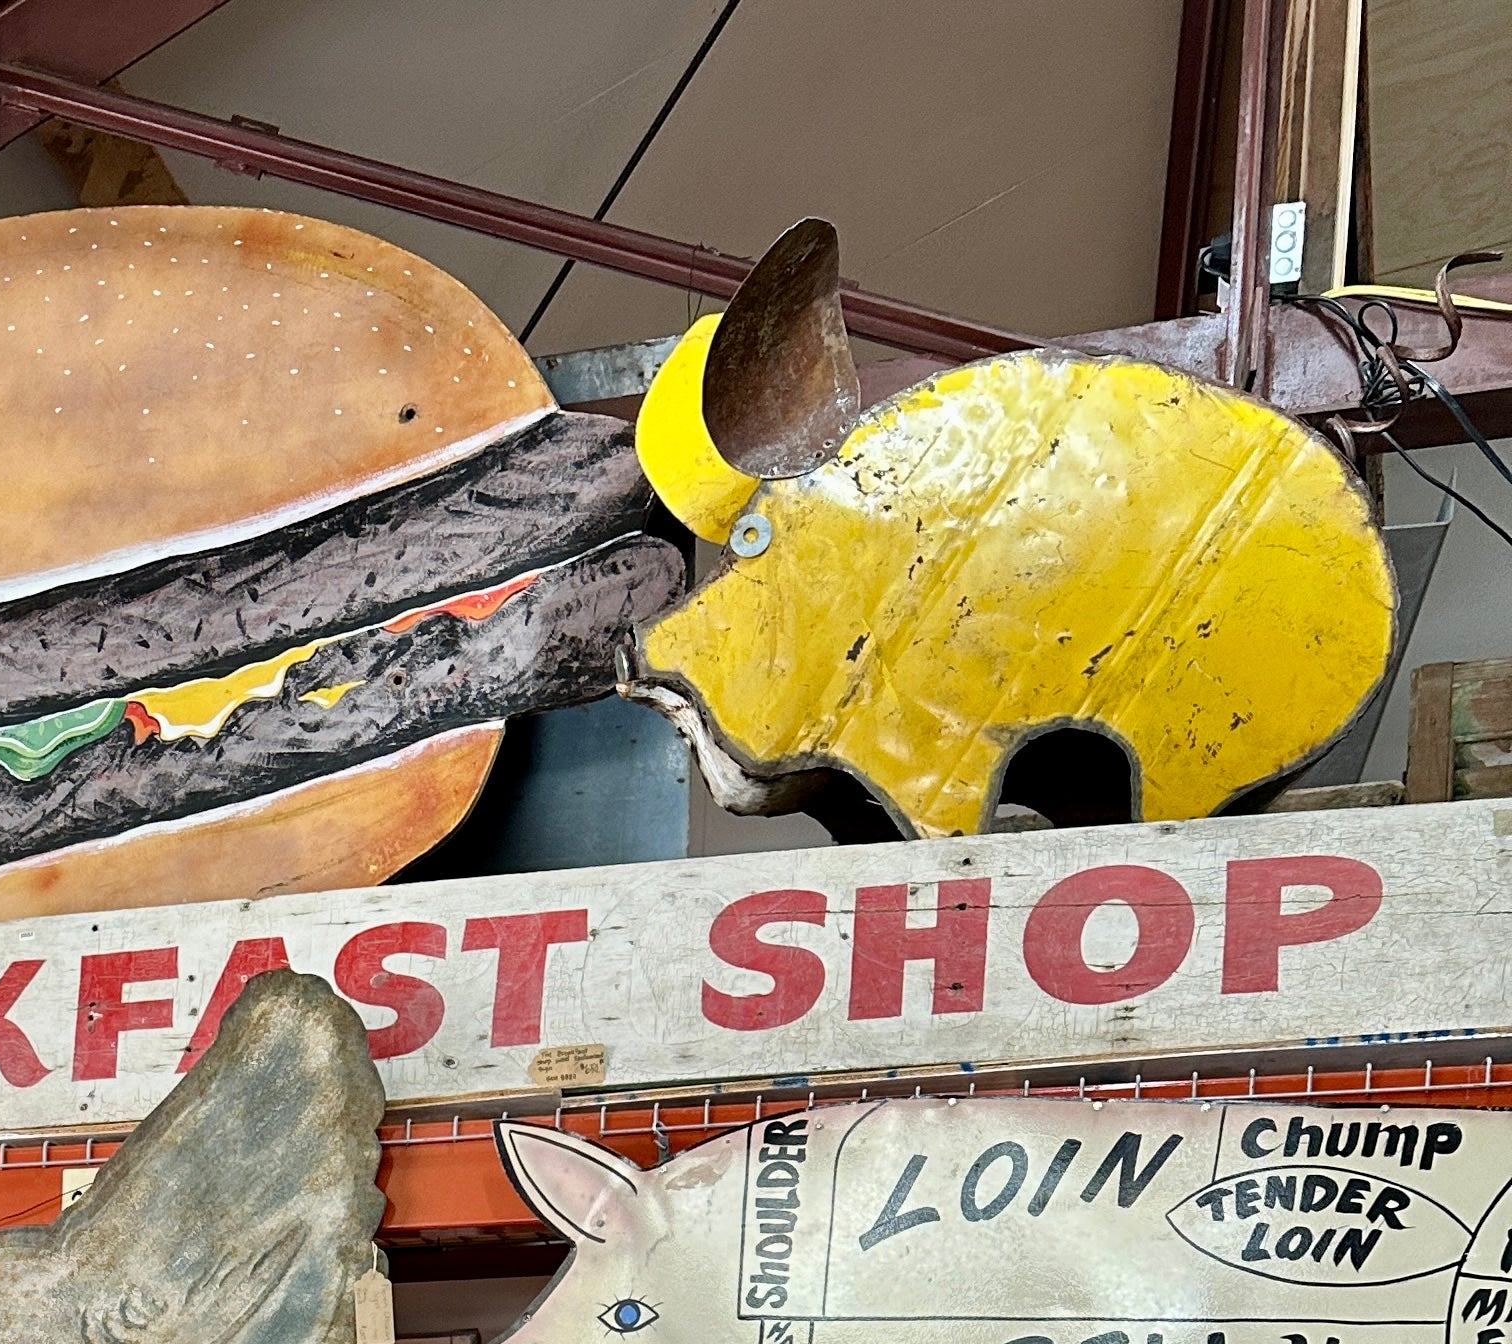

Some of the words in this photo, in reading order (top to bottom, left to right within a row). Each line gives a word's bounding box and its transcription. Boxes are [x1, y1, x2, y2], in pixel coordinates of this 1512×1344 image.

[700, 854, 1385, 1032] SHOP
[859, 1131, 1184, 1252] LOIN
[1195, 1173, 1415, 1231] TENDER
[1241, 1222, 1385, 1273] LOIN
